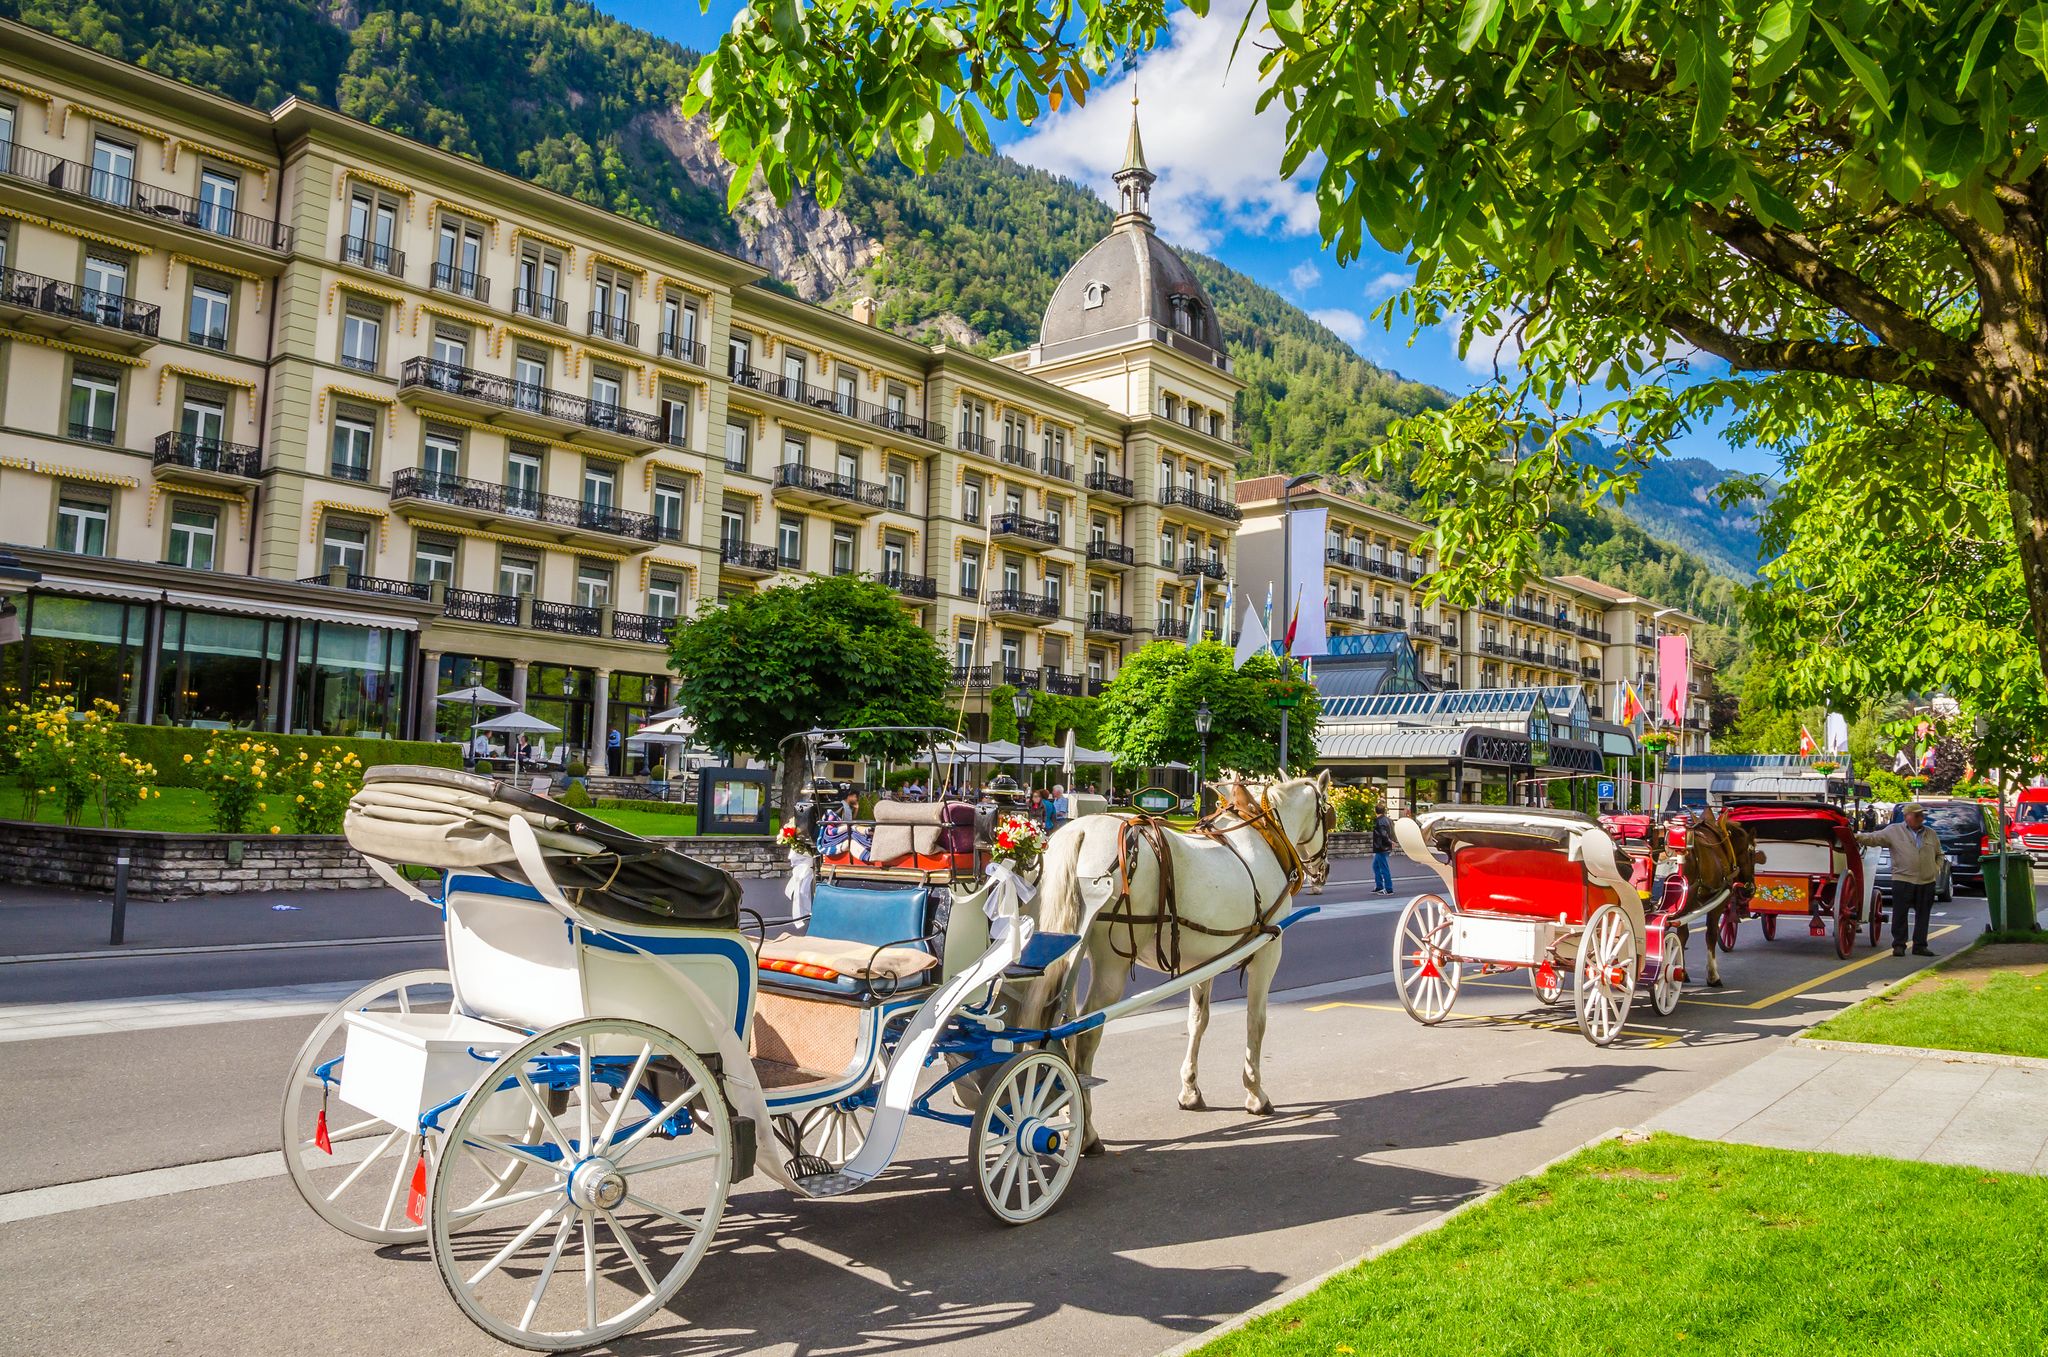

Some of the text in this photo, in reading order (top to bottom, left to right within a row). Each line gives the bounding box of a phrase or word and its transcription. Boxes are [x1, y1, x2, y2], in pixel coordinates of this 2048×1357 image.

[1602, 785, 1609, 794] P
[1544, 974, 1555, 987] 76
[415, 1193, 426, 1219] 80
